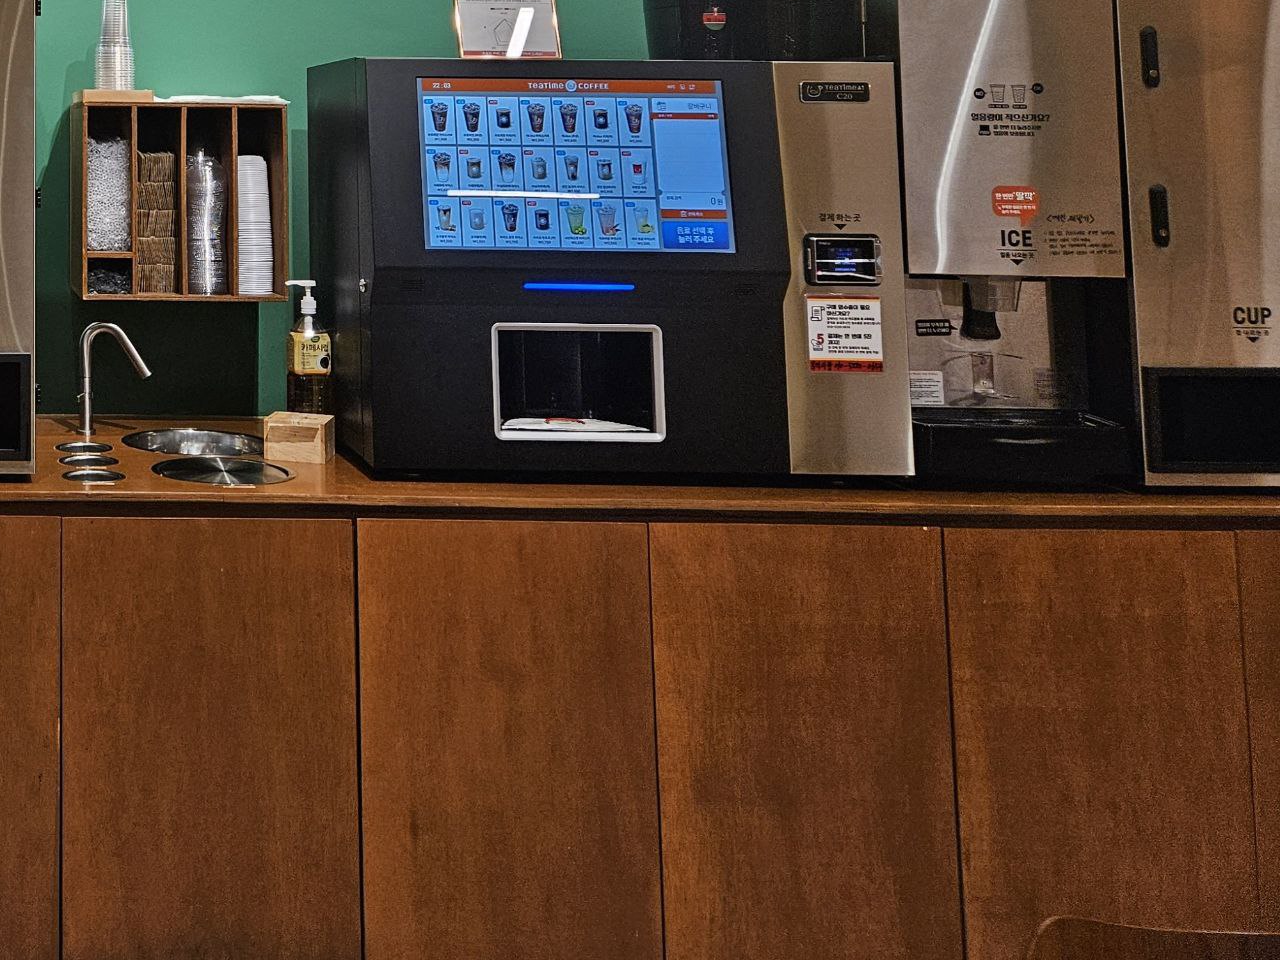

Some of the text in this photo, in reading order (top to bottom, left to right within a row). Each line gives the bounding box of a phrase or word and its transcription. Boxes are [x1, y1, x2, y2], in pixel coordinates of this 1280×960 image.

[528, 81, 609, 90] TeaTime COFFEE
[836, 214, 852, 222] 하는
[853, 214, 861, 223] 곳
[677, 226, 714, 235] 음료 선택 후
[693, 235, 714, 244] 주세요
[1001, 229, 1033, 247] ICE
[1233, 306, 1271, 324] CUP
